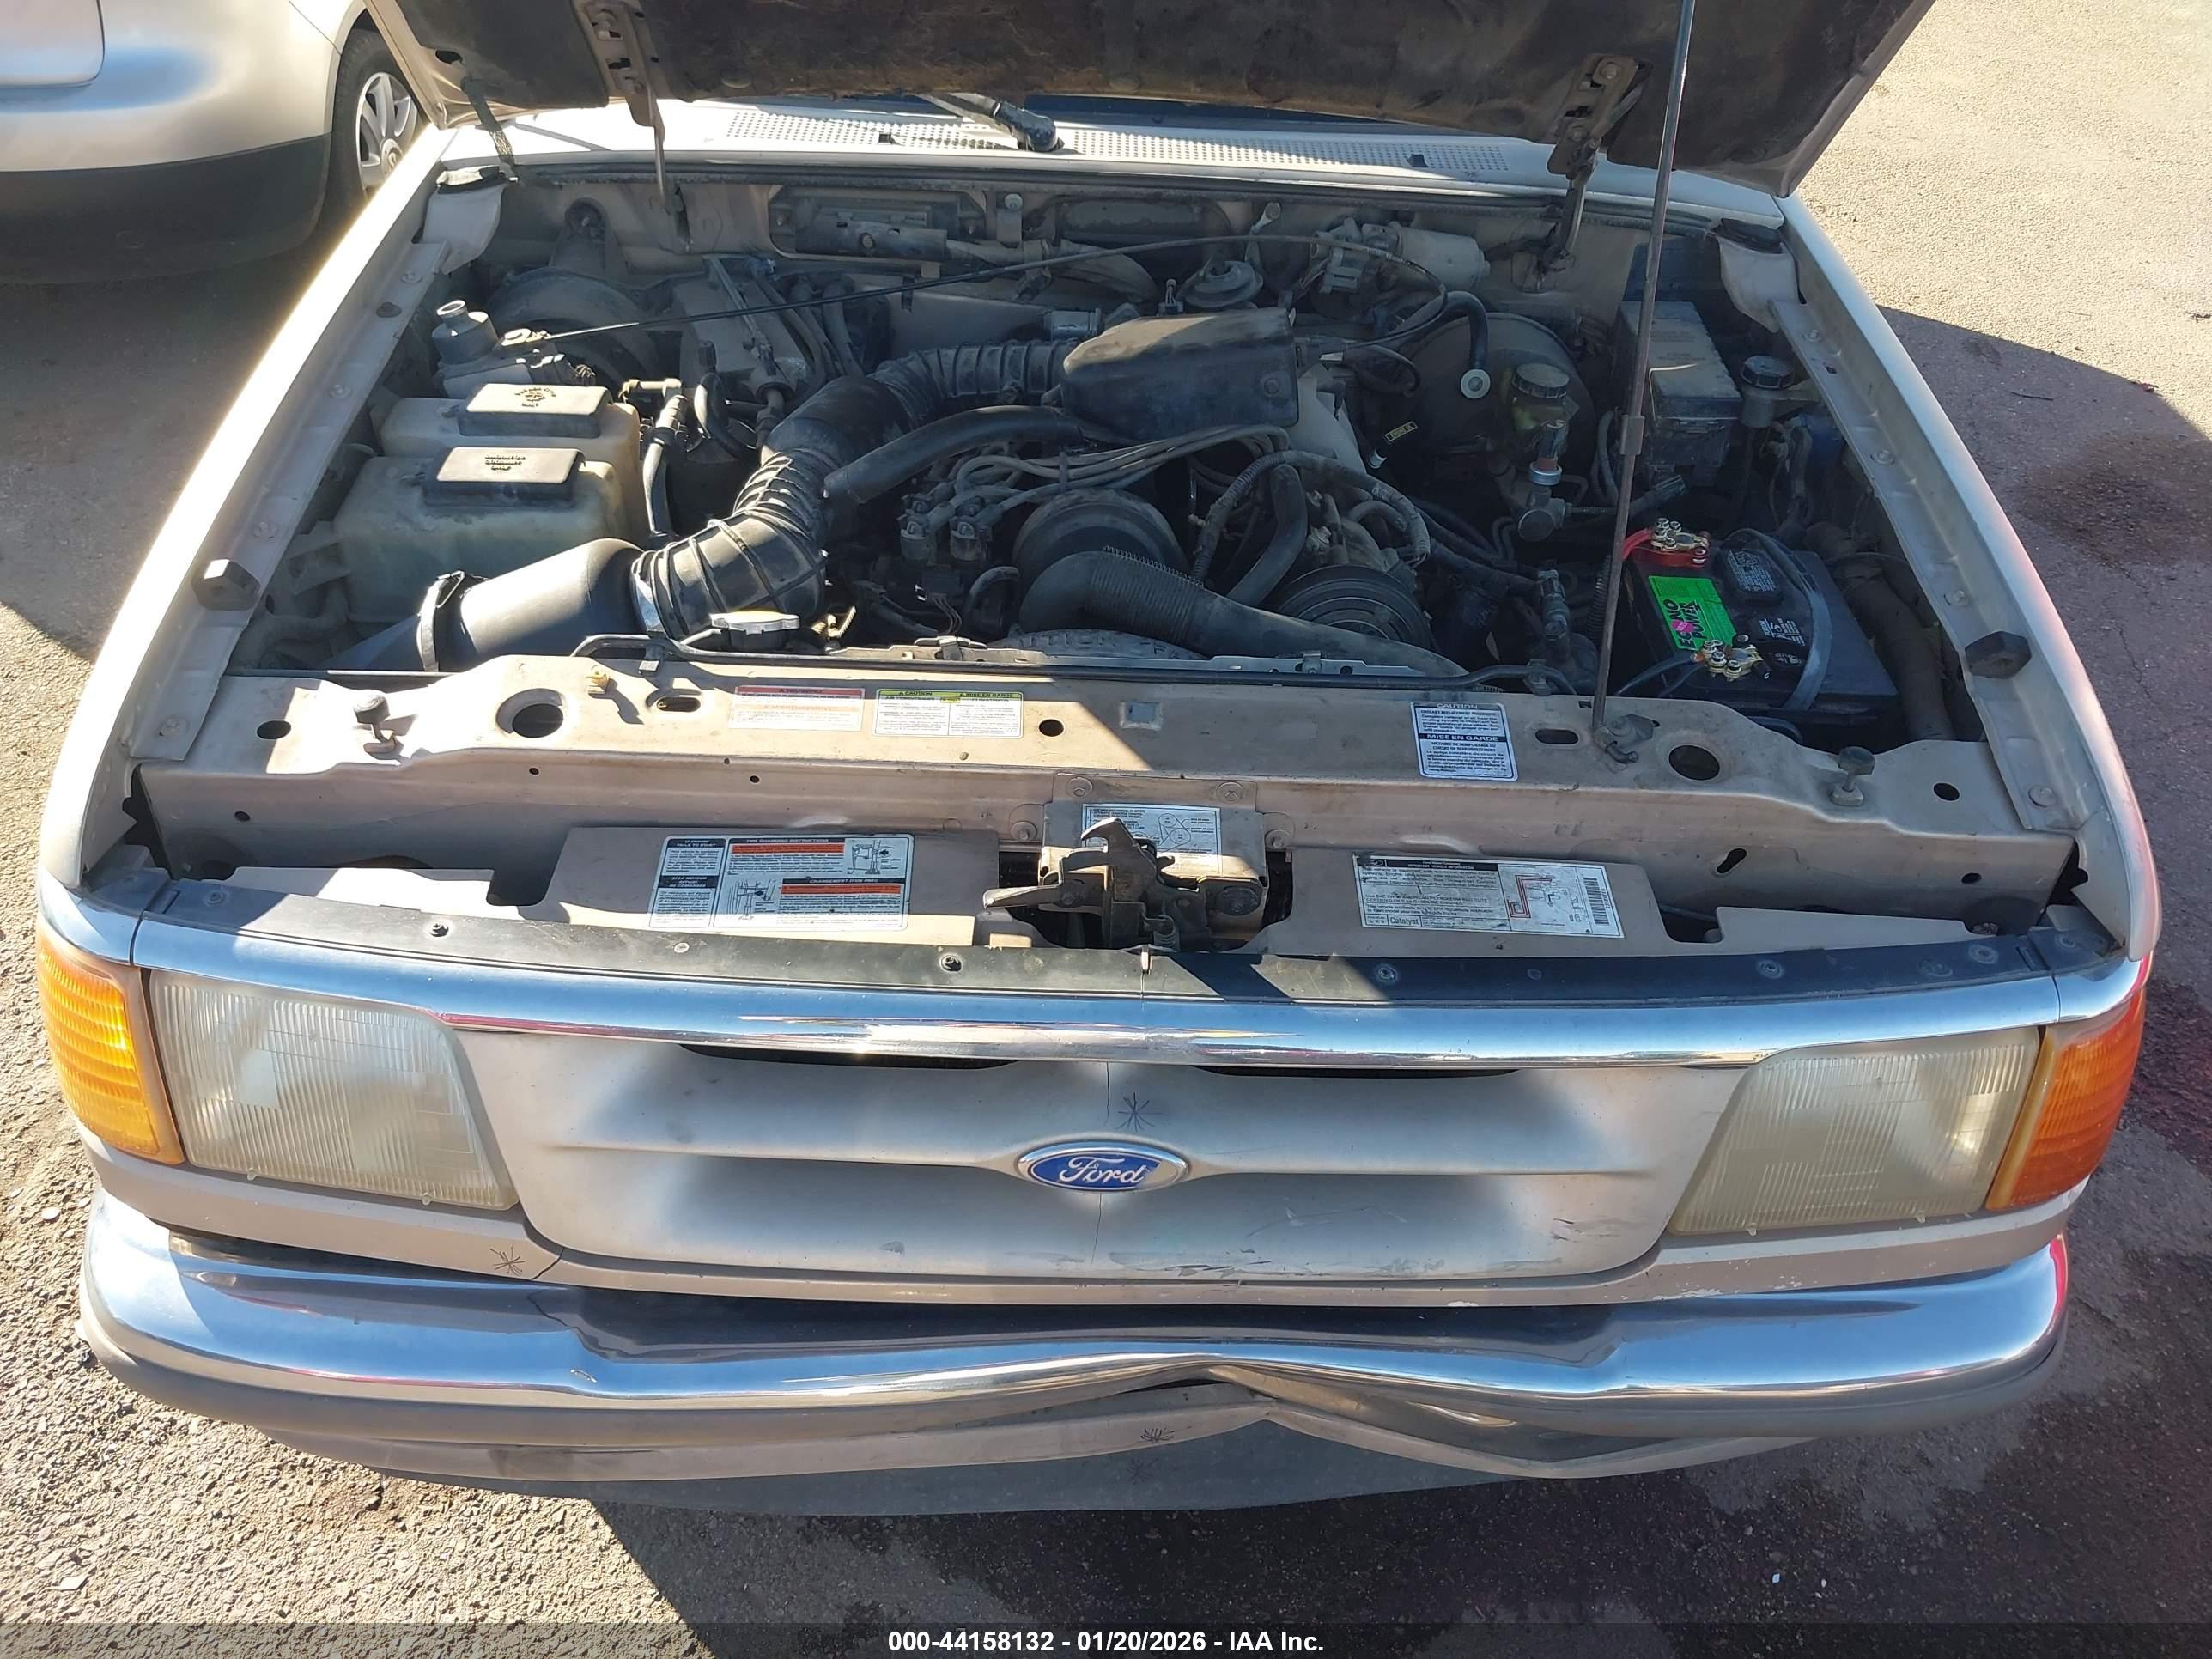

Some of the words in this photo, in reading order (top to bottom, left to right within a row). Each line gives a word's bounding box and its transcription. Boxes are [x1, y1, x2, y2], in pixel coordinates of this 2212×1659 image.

[1662, 599, 1698, 649] ECNO
[1680, 600, 1706, 639] POWER
[1389, 916, 1419, 926] Catalyst
[1059, 1156, 1147, 1184] Ford
